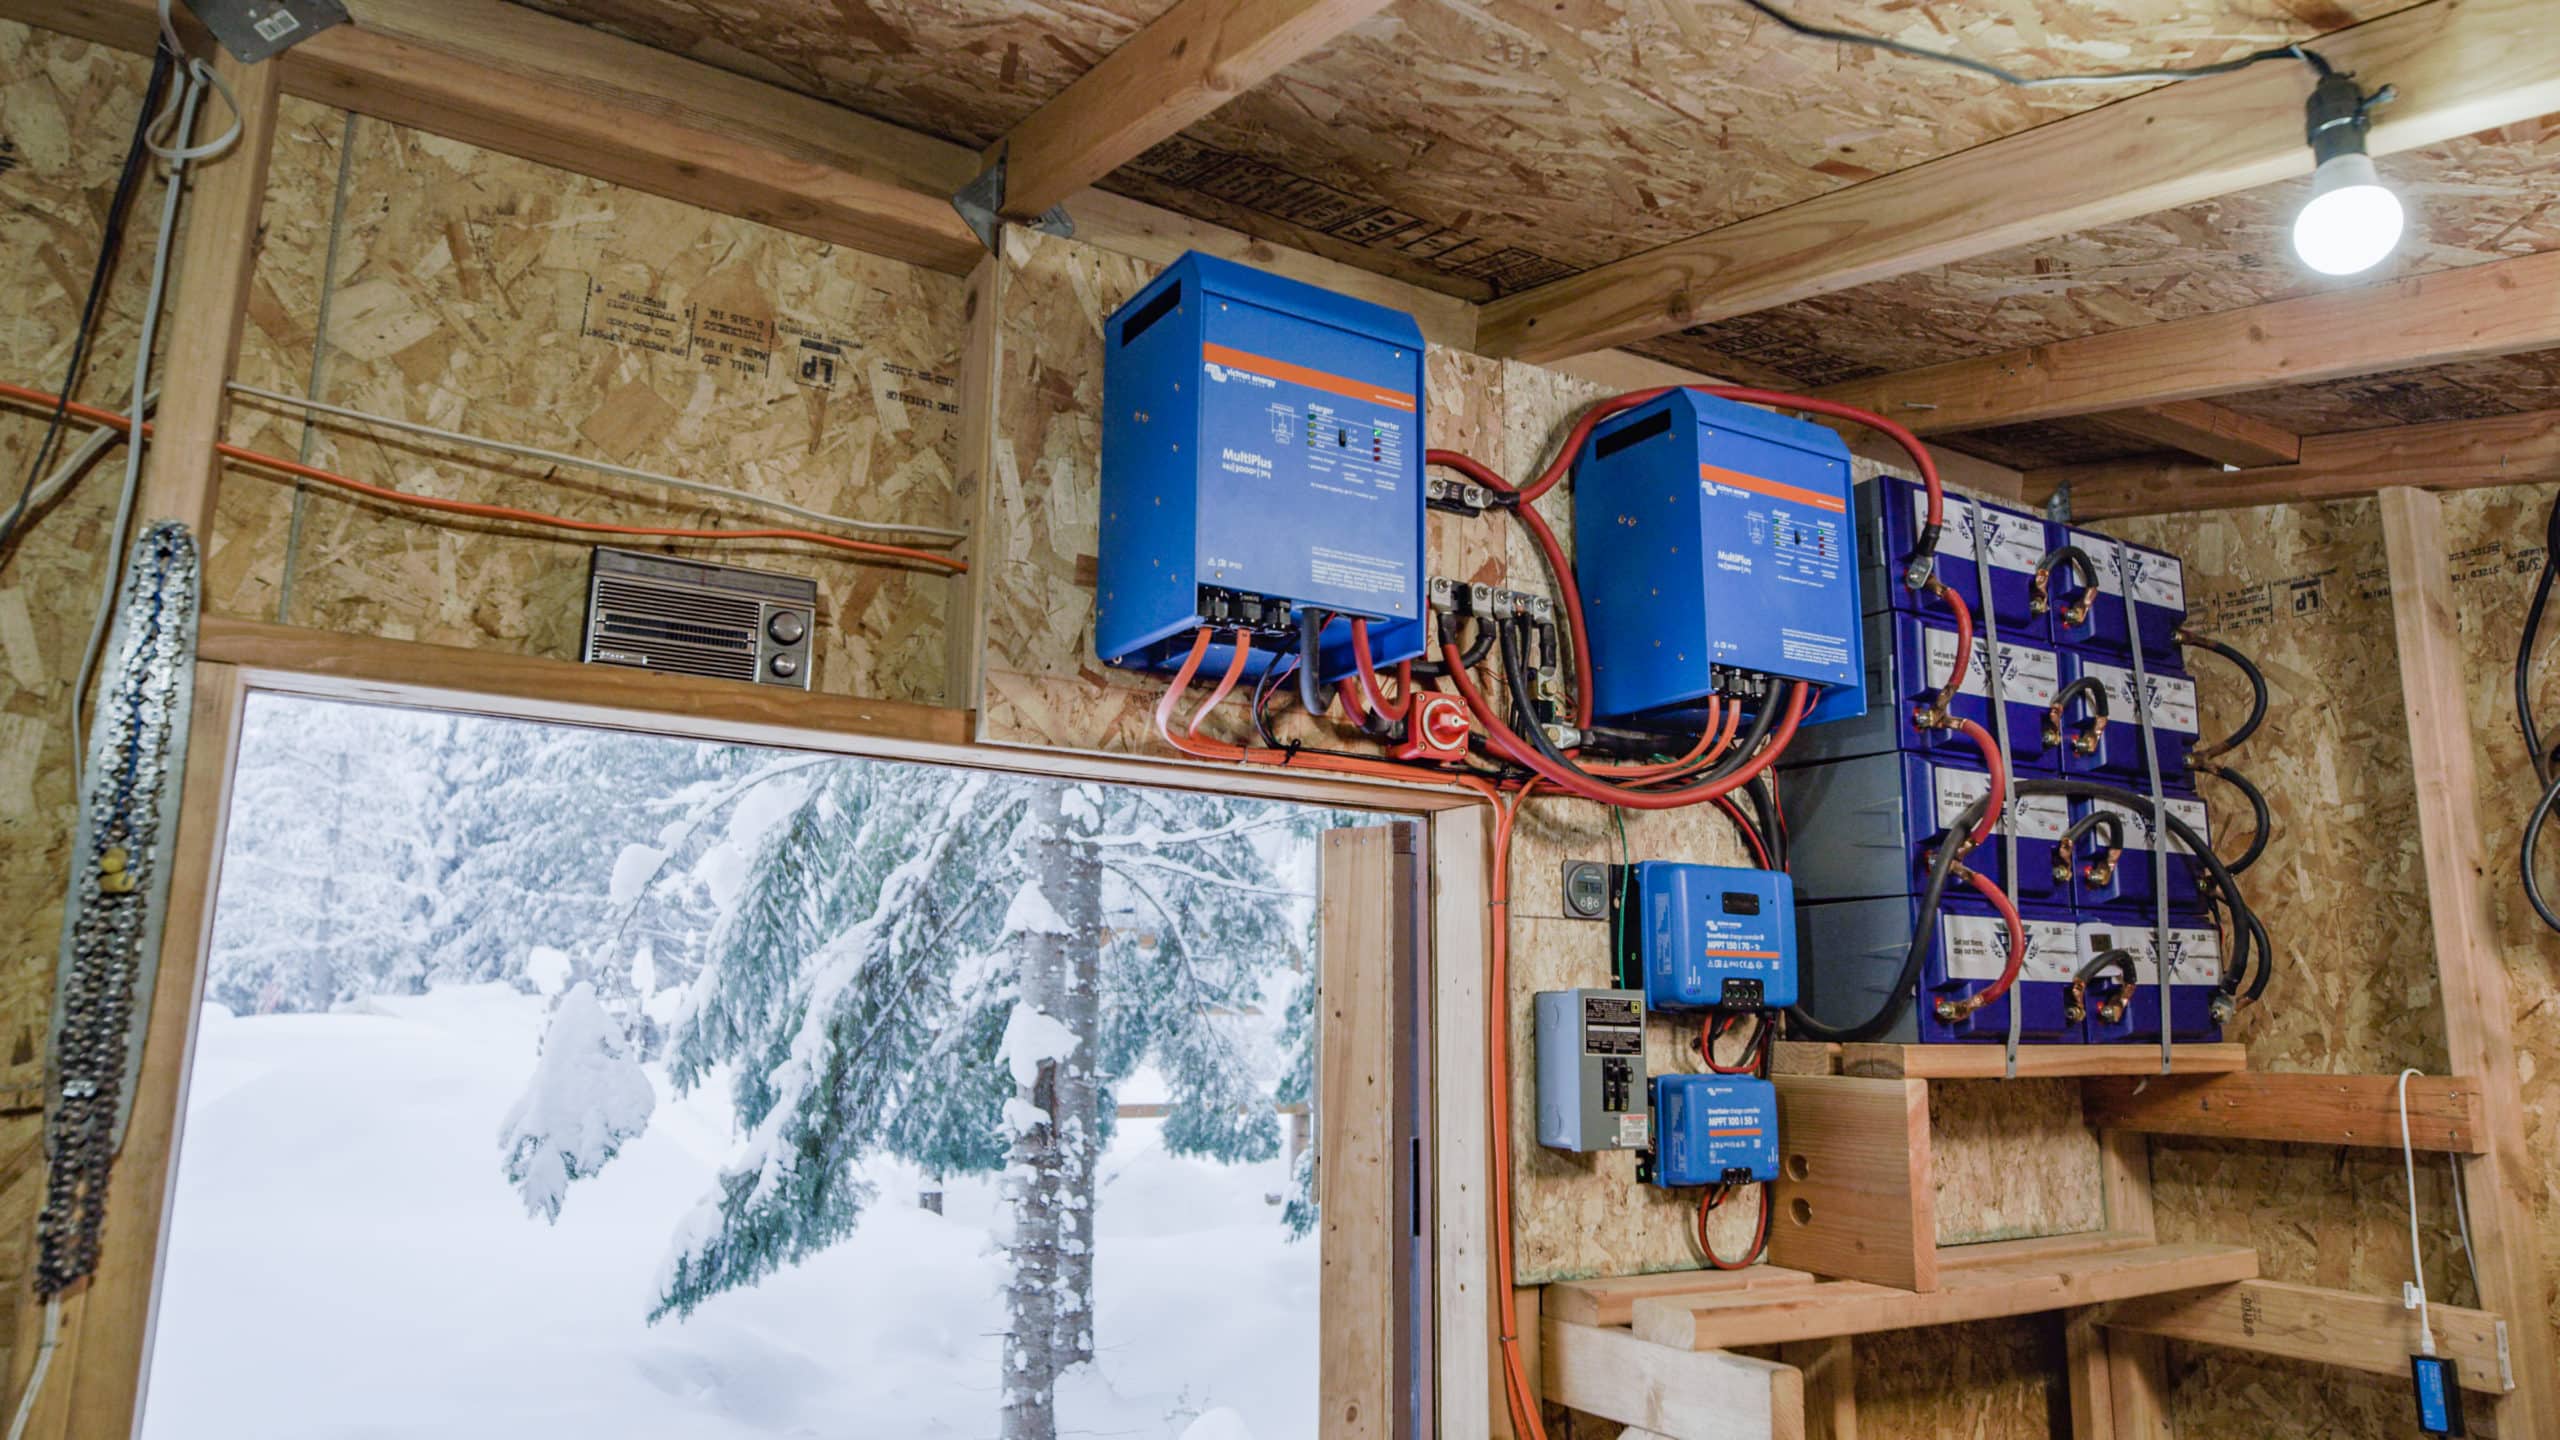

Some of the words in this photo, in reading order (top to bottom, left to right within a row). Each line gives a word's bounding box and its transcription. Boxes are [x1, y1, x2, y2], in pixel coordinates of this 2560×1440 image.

[729, 358, 756, 374] MILL
[802, 355, 833, 385] LP
[1222, 447, 1273, 470] MultiPlus
[2295, 590, 2318, 612] LP
[1707, 941, 1725, 949] MPPT
[1708, 1116, 1727, 1127] MPPT
